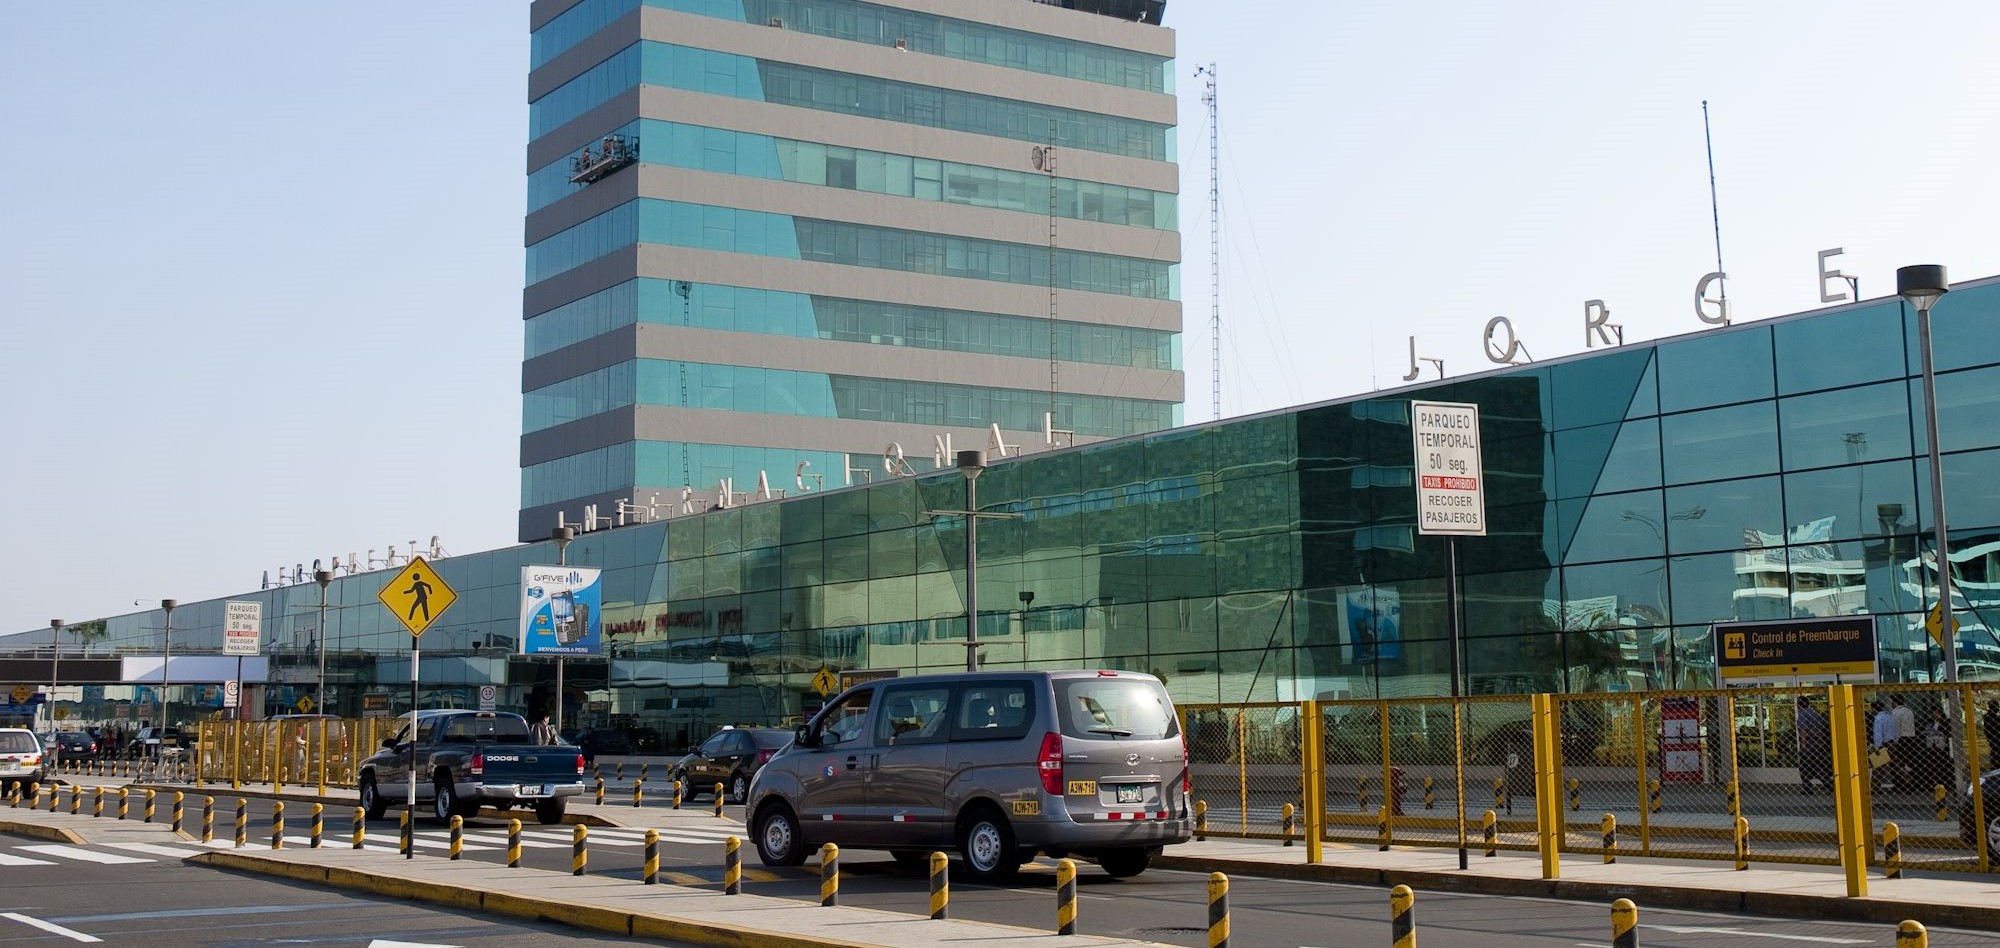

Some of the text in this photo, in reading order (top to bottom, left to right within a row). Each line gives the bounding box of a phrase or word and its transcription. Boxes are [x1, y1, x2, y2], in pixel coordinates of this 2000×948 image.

[1403, 247, 1847, 381] JORGE
[1421, 413, 1470, 429] PARQUEO
[1420, 432, 1475, 449] TEMPORAL
[1430, 453, 1468, 475] 50 seg.
[1423, 476, 1476, 490] TAXIS PROHIBIDO
[1428, 495, 1473, 507] RECOGER
[1426, 511, 1478, 524] PASAJEROS
[230, 605, 258, 613] PARQUEO
[229, 613, 258, 621] TEMPORAL
[232, 621, 240, 630] 50
[1751, 629, 1860, 645] Control de Preembarque
[1752, 649, 1783, 659] Check In
[1069, 781, 1095, 794] A3W-718
